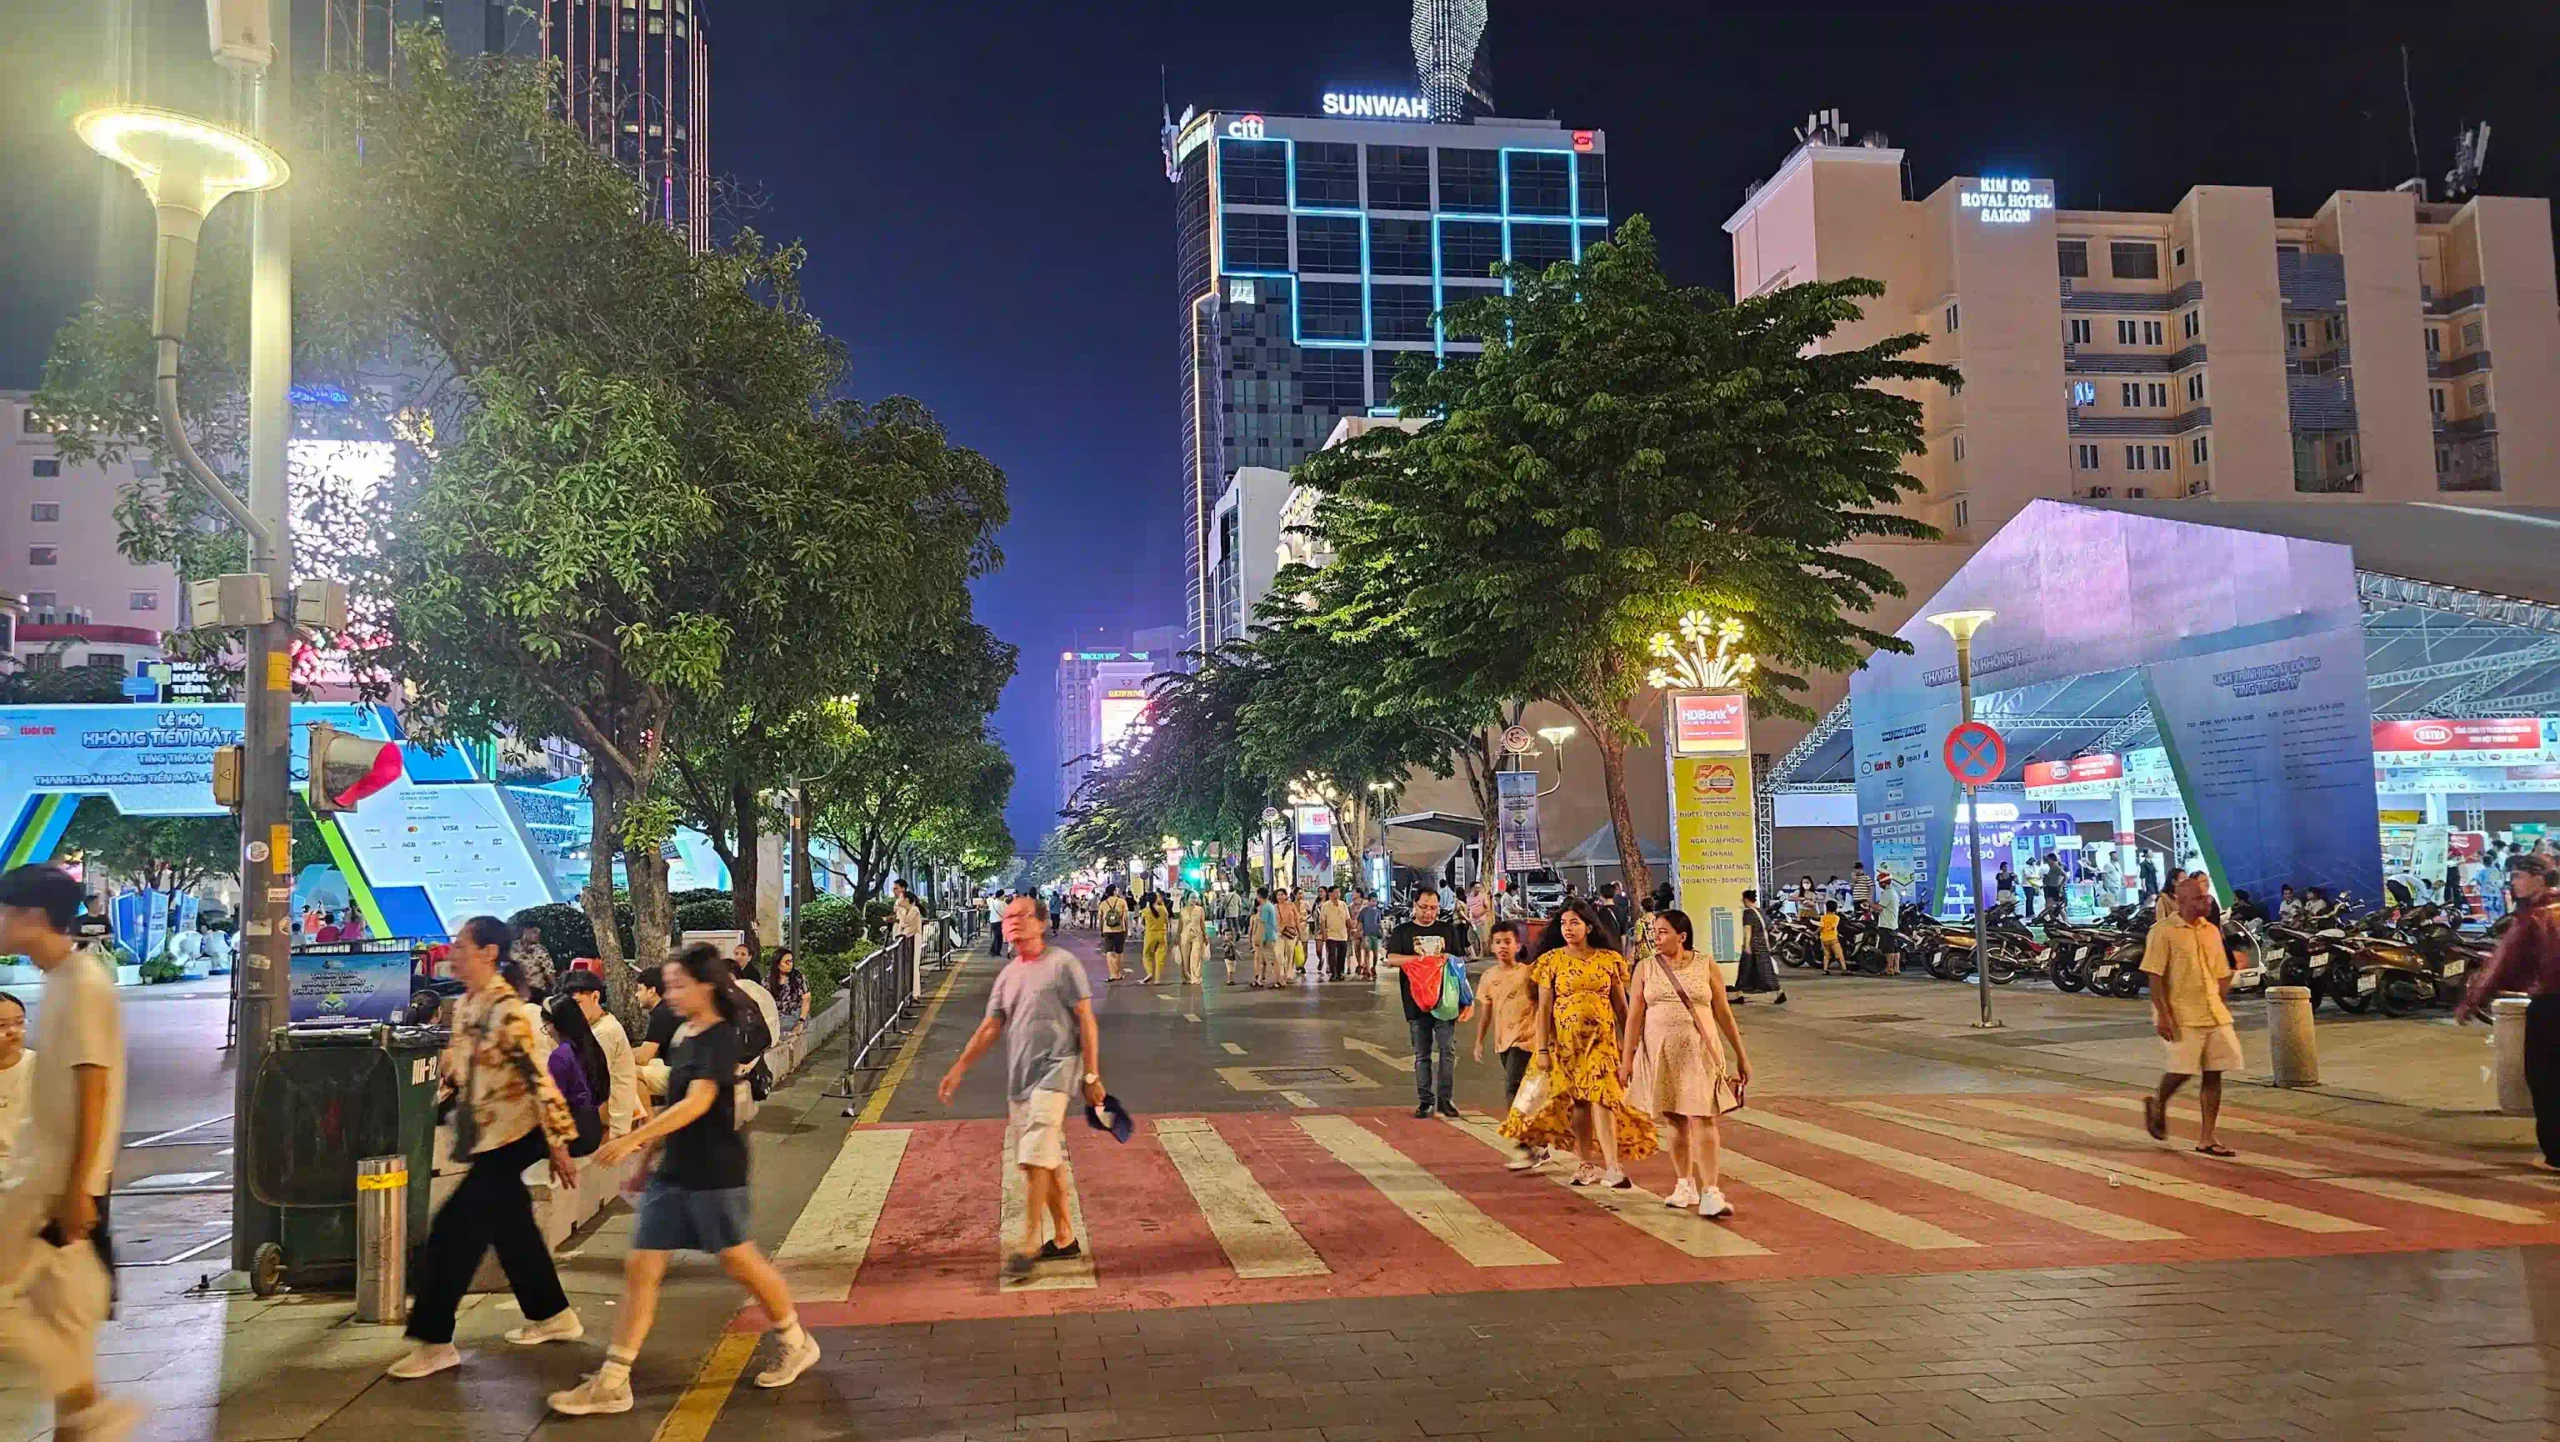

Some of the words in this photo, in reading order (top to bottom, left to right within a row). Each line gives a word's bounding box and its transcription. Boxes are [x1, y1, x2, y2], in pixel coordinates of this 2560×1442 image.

[1323, 93, 1428, 118] SUNWAH
[1228, 120, 1264, 139] citi
[1981, 178, 2008, 193] KIM
[2011, 179, 2030, 193] DO
[1961, 193, 2006, 208] ROYAL
[2008, 194, 2053, 209] HOTEL
[1981, 209, 2031, 222] SAIGON
[1923, 668, 1953, 687] THANH
[1979, 652, 2016, 675] KHÔNG
[2233, 683, 2256, 698] TING
[2257, 679, 2279, 695] TING
[171, 696, 204, 704] 2025
[178, 711, 204, 727] HỘI
[1682, 709, 1727, 721] HDBank
[82, 728, 148, 748] KHÔNG
[150, 728, 189, 748] TIỀN
[191, 728, 232, 749] MẶT
[138, 753, 166, 765] TING
[168, 753, 194, 765] TING
[34, 775, 73, 786] THANH
[106, 772, 148, 785] KHÔNG
